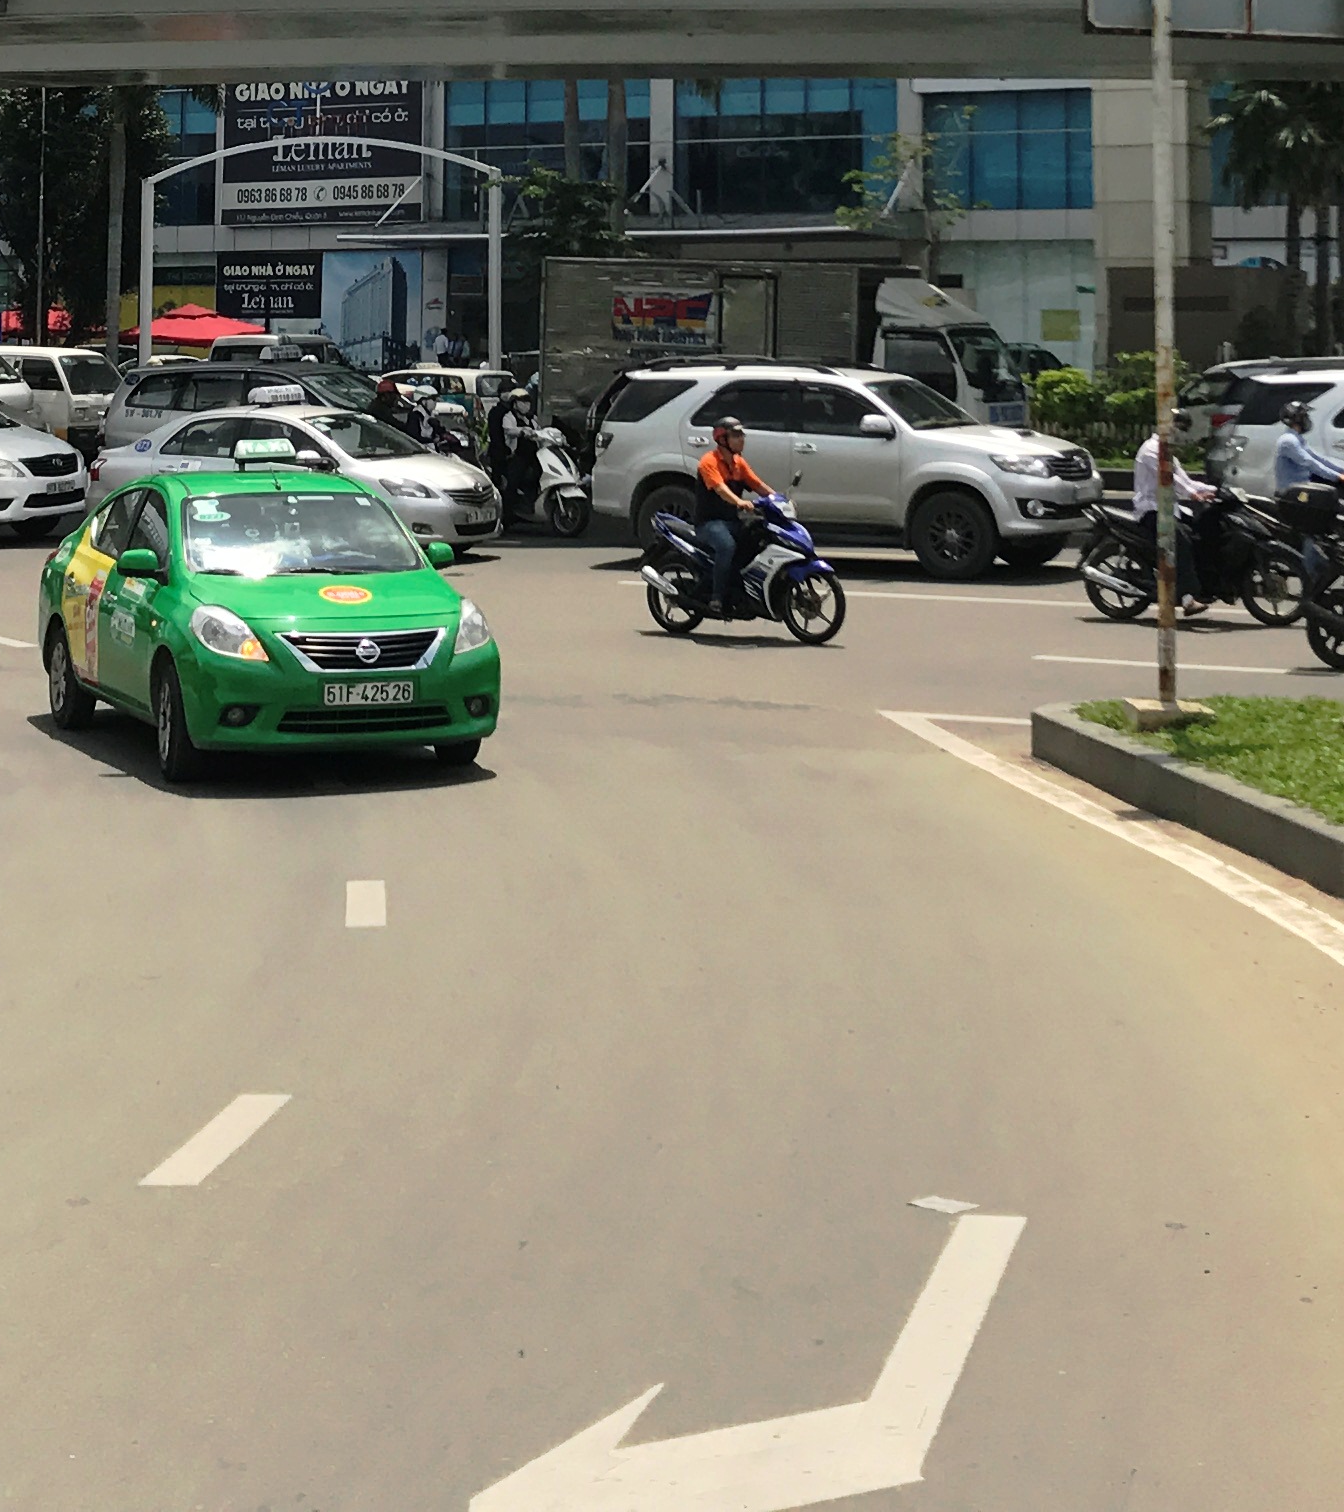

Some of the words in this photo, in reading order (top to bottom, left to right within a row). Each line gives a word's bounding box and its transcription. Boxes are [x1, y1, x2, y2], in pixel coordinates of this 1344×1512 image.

[235, 82, 285, 102] GIAO
[355, 81, 408, 97] NGAY
[237, 117, 256, 131] tại
[371, 107, 391, 123] có
[237, 188, 262, 204] 0963
[264, 187, 277, 203] 86
[279, 187, 292, 203] 68
[294, 186, 307, 202] 78
[332, 184, 359, 201] 0945
[361, 183, 374, 200] 86
[376, 183, 389, 199] 68
[392, 182, 405, 199] 78
[223, 265, 250, 277] GIAO
[251, 262, 273, 276] NHÀ
[286, 264, 315, 276] NGAY
